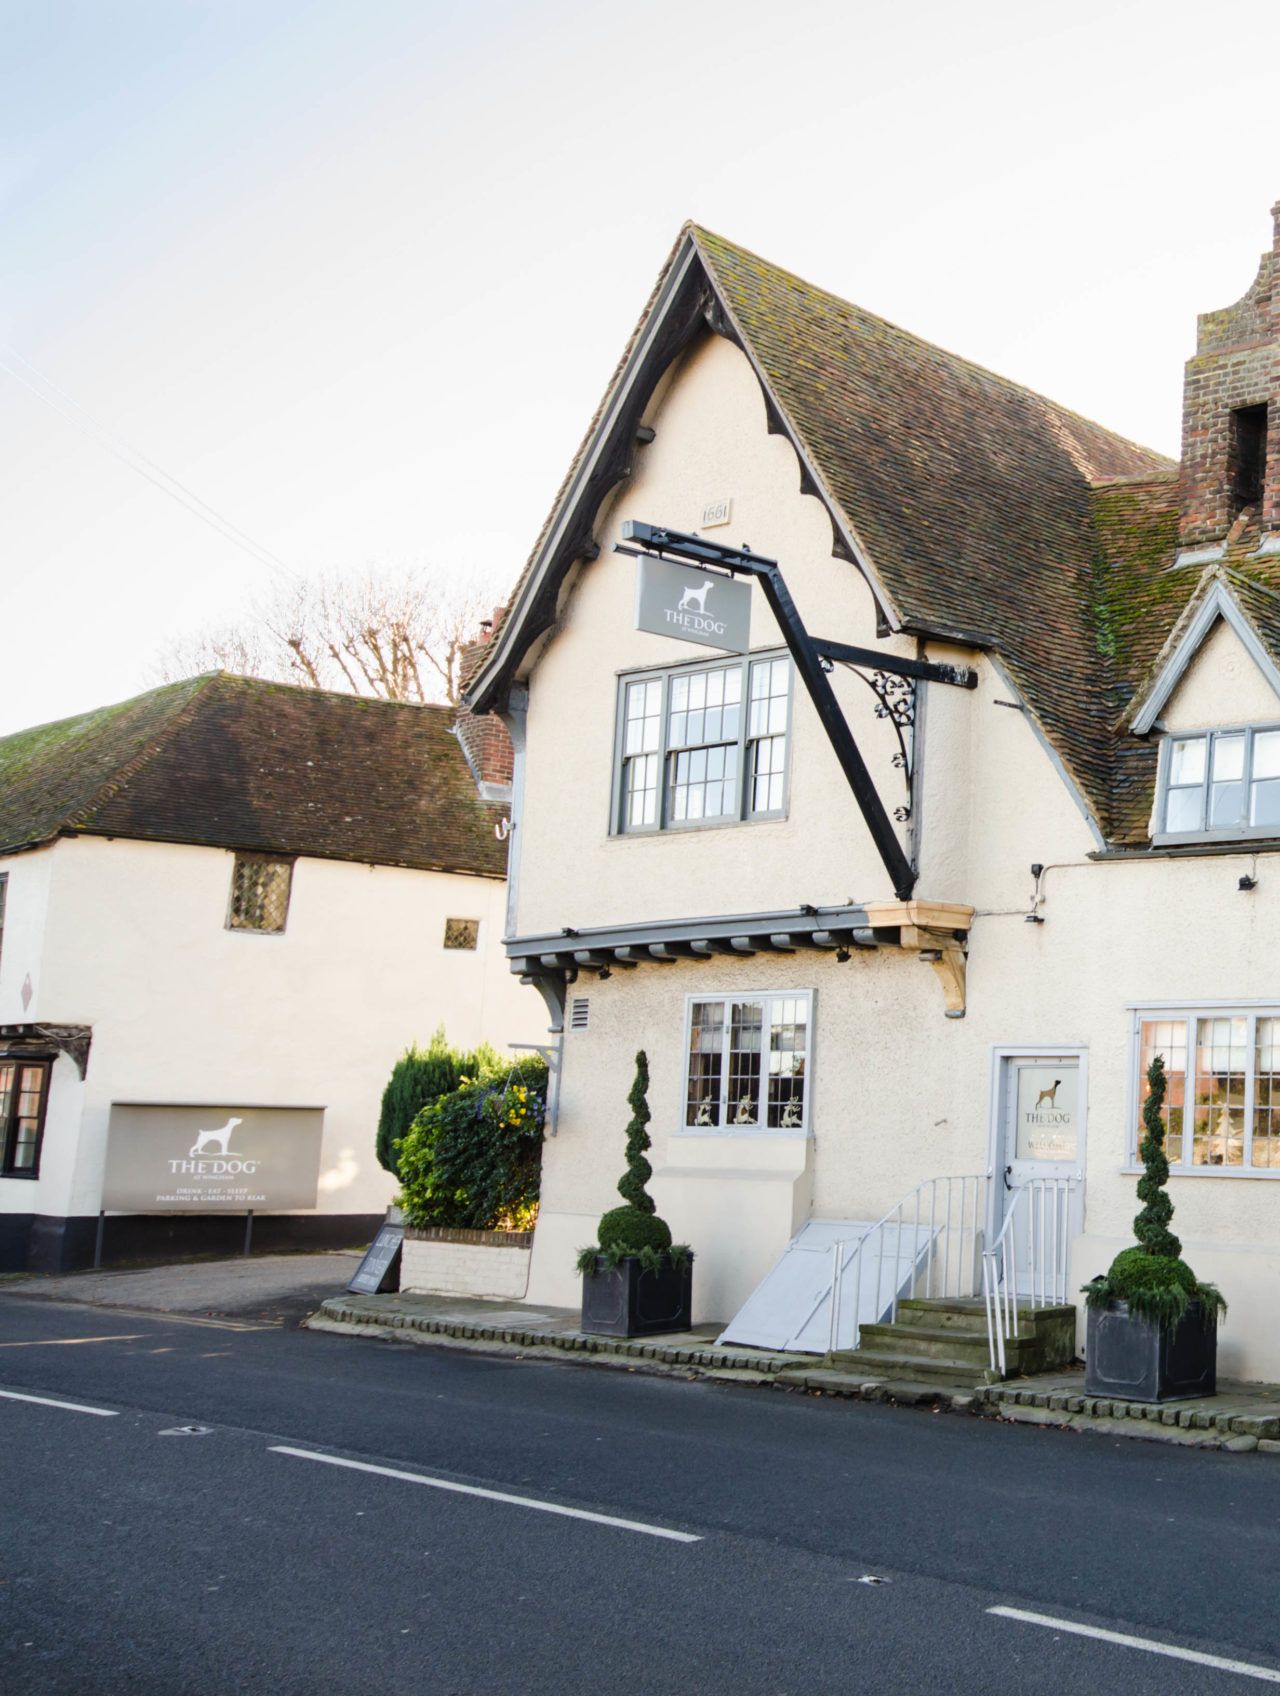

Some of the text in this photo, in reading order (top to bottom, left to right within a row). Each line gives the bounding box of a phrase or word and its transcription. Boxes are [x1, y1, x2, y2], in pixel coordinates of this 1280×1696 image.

[664, 608, 690, 626] THE
[694, 616, 724, 634] DOG
[1025, 1112, 1070, 1124] THE DOG
[168, 1160, 256, 1174] THE DOG
